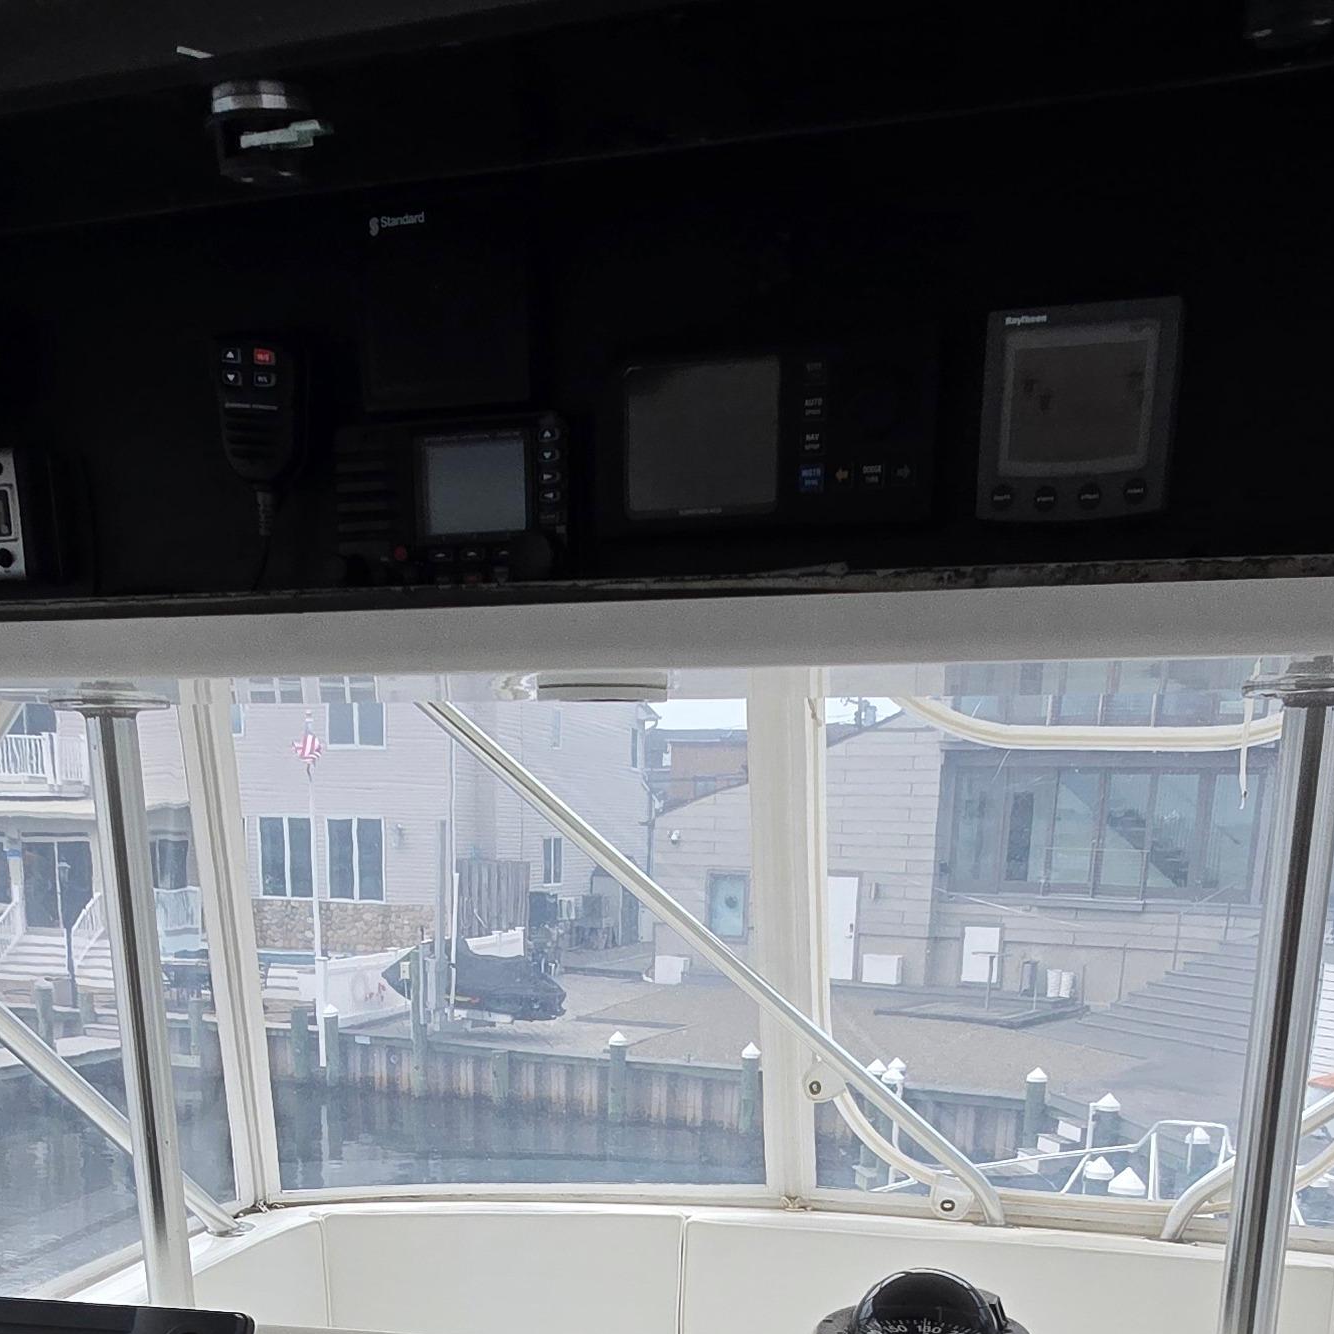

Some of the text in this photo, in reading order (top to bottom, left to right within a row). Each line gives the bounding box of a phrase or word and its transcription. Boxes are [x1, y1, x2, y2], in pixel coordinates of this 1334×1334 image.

[380, 211, 426, 229] Standard
[1004, 315, 1048, 326] Raytheon
[884, 1324, 908, 1334] 150
